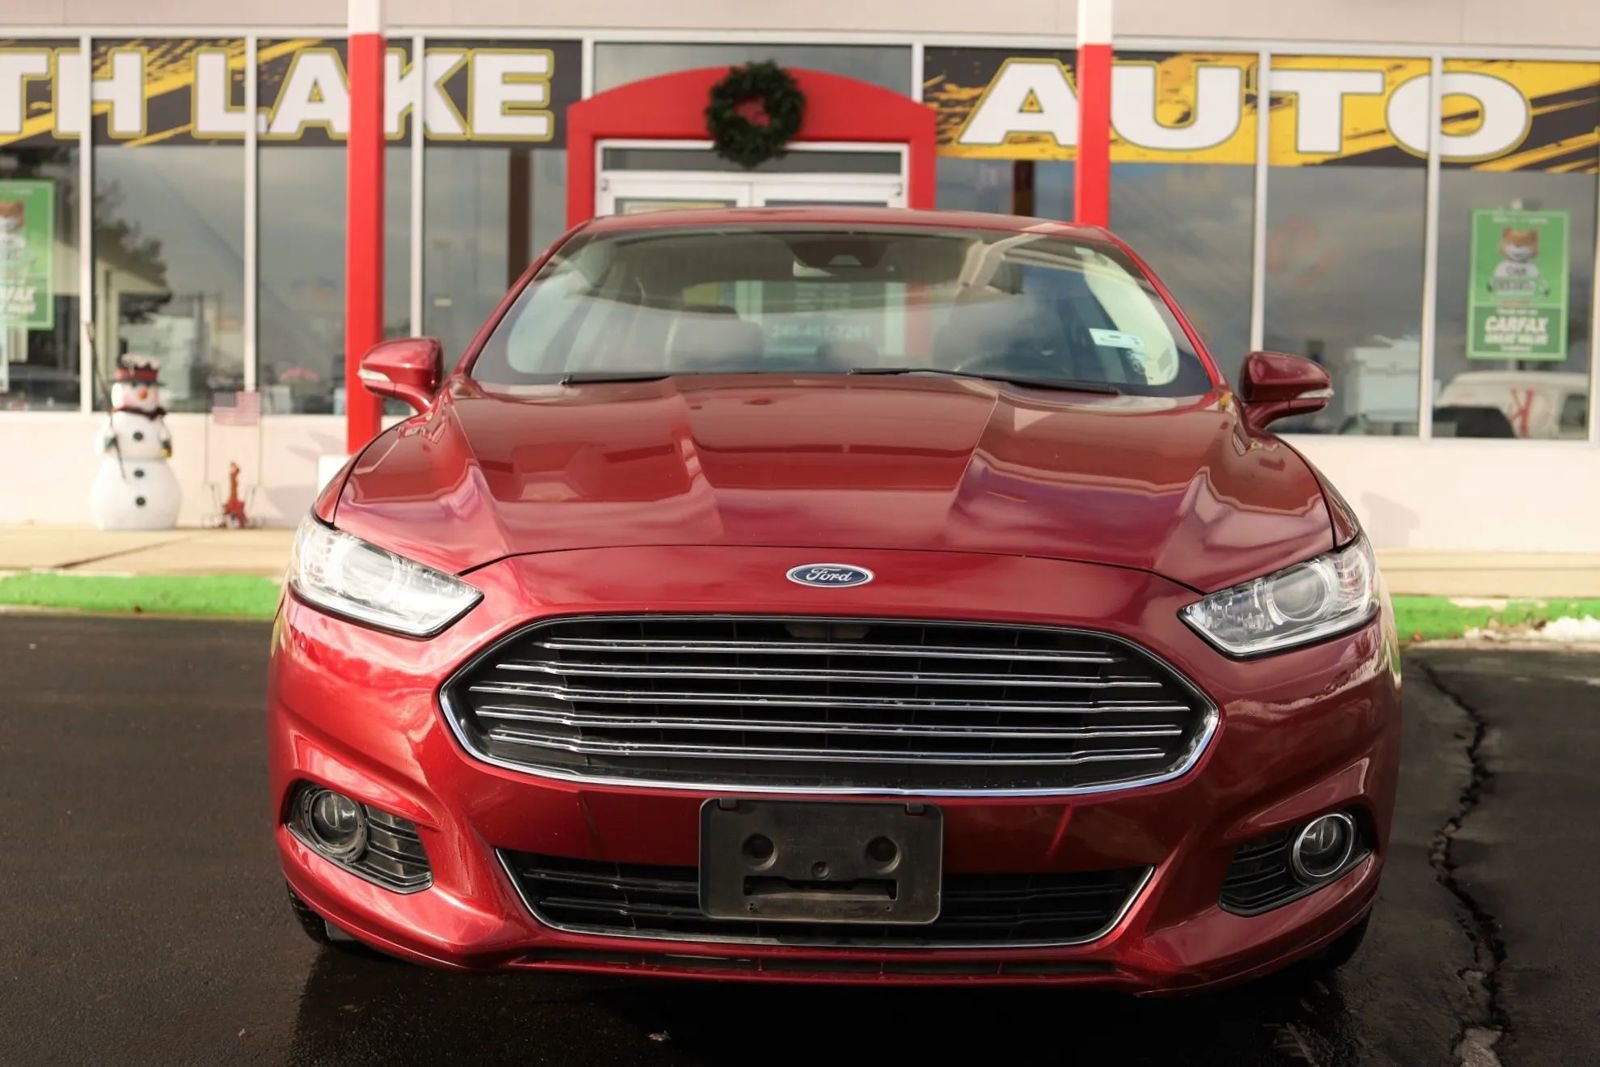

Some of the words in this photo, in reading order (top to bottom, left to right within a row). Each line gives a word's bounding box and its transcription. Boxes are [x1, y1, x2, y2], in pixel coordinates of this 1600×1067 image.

[193, 48, 554, 141] LAKE
[956, 58, 1531, 161] AUTO
[1485, 315, 1549, 333] CARFAX
[806, 568, 854, 582] Ford
